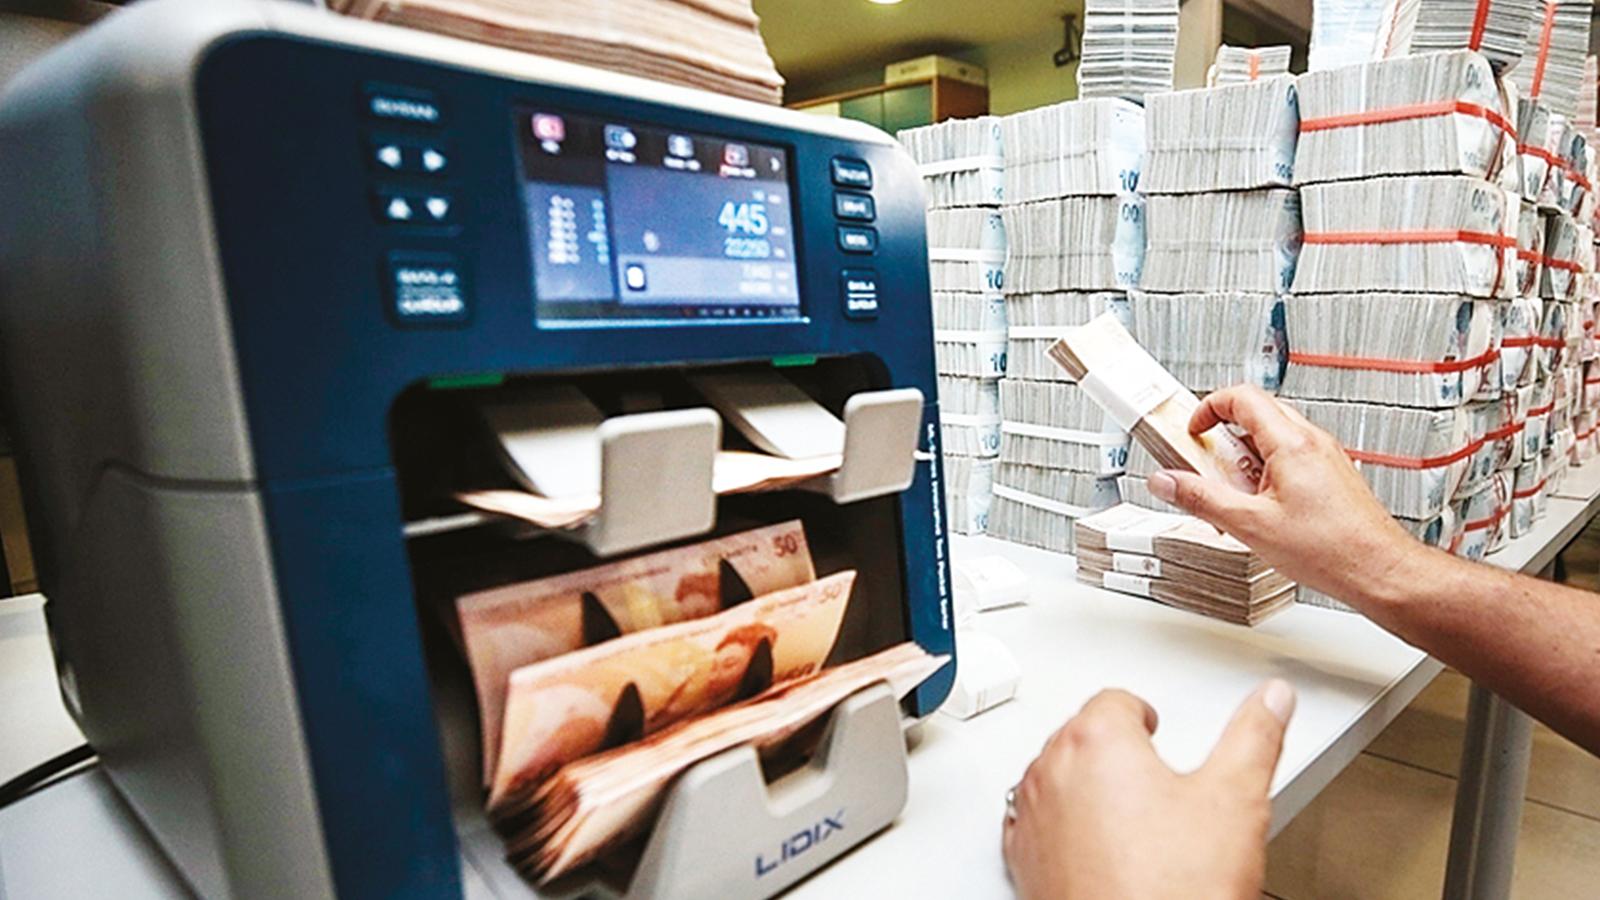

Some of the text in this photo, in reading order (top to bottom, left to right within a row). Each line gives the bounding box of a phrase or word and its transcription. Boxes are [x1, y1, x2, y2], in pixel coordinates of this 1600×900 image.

[718, 201, 768, 236] 445
[772, 533, 799, 558] 50
[755, 806, 846, 878] LIDIX
